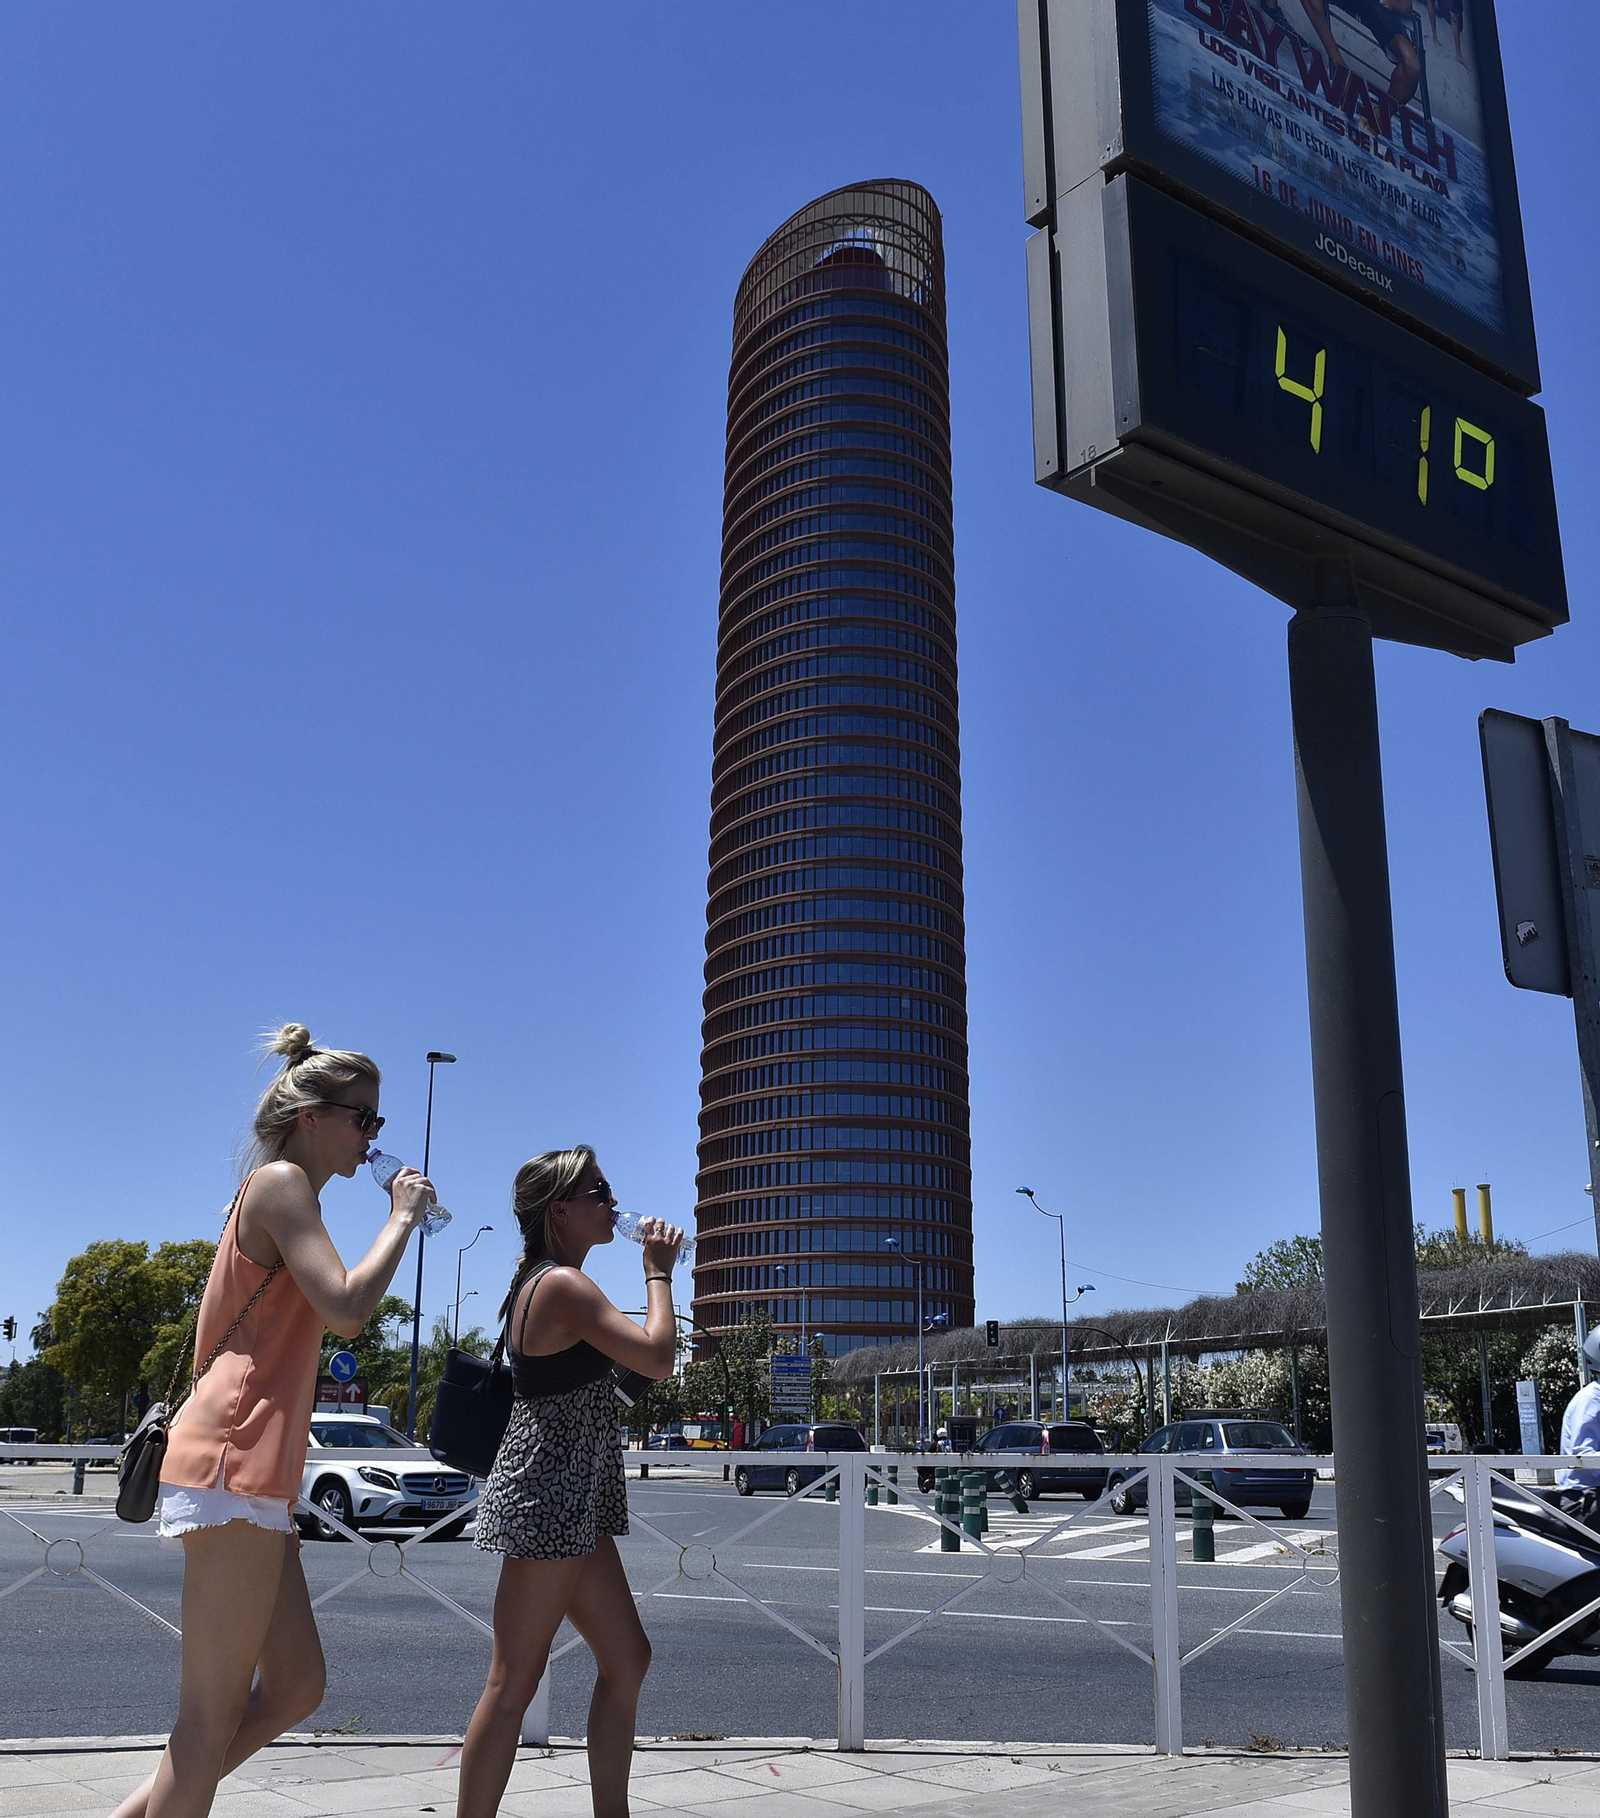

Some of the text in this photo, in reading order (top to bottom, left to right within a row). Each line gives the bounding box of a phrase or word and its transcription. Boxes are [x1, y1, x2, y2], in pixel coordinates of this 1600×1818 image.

[1198, 28, 1450, 199] LOS VIGILANTES DE LA PLAYA
[1212, 71, 1442, 229] LAS PLAYAS NO ESTÁN LISTAS PARA ELLOS
[1252, 163, 1425, 284] 16 DE JUNIO EN CINES
[1314, 232, 1394, 293] JCDecaux
[1080, 444, 1097, 463] 18
